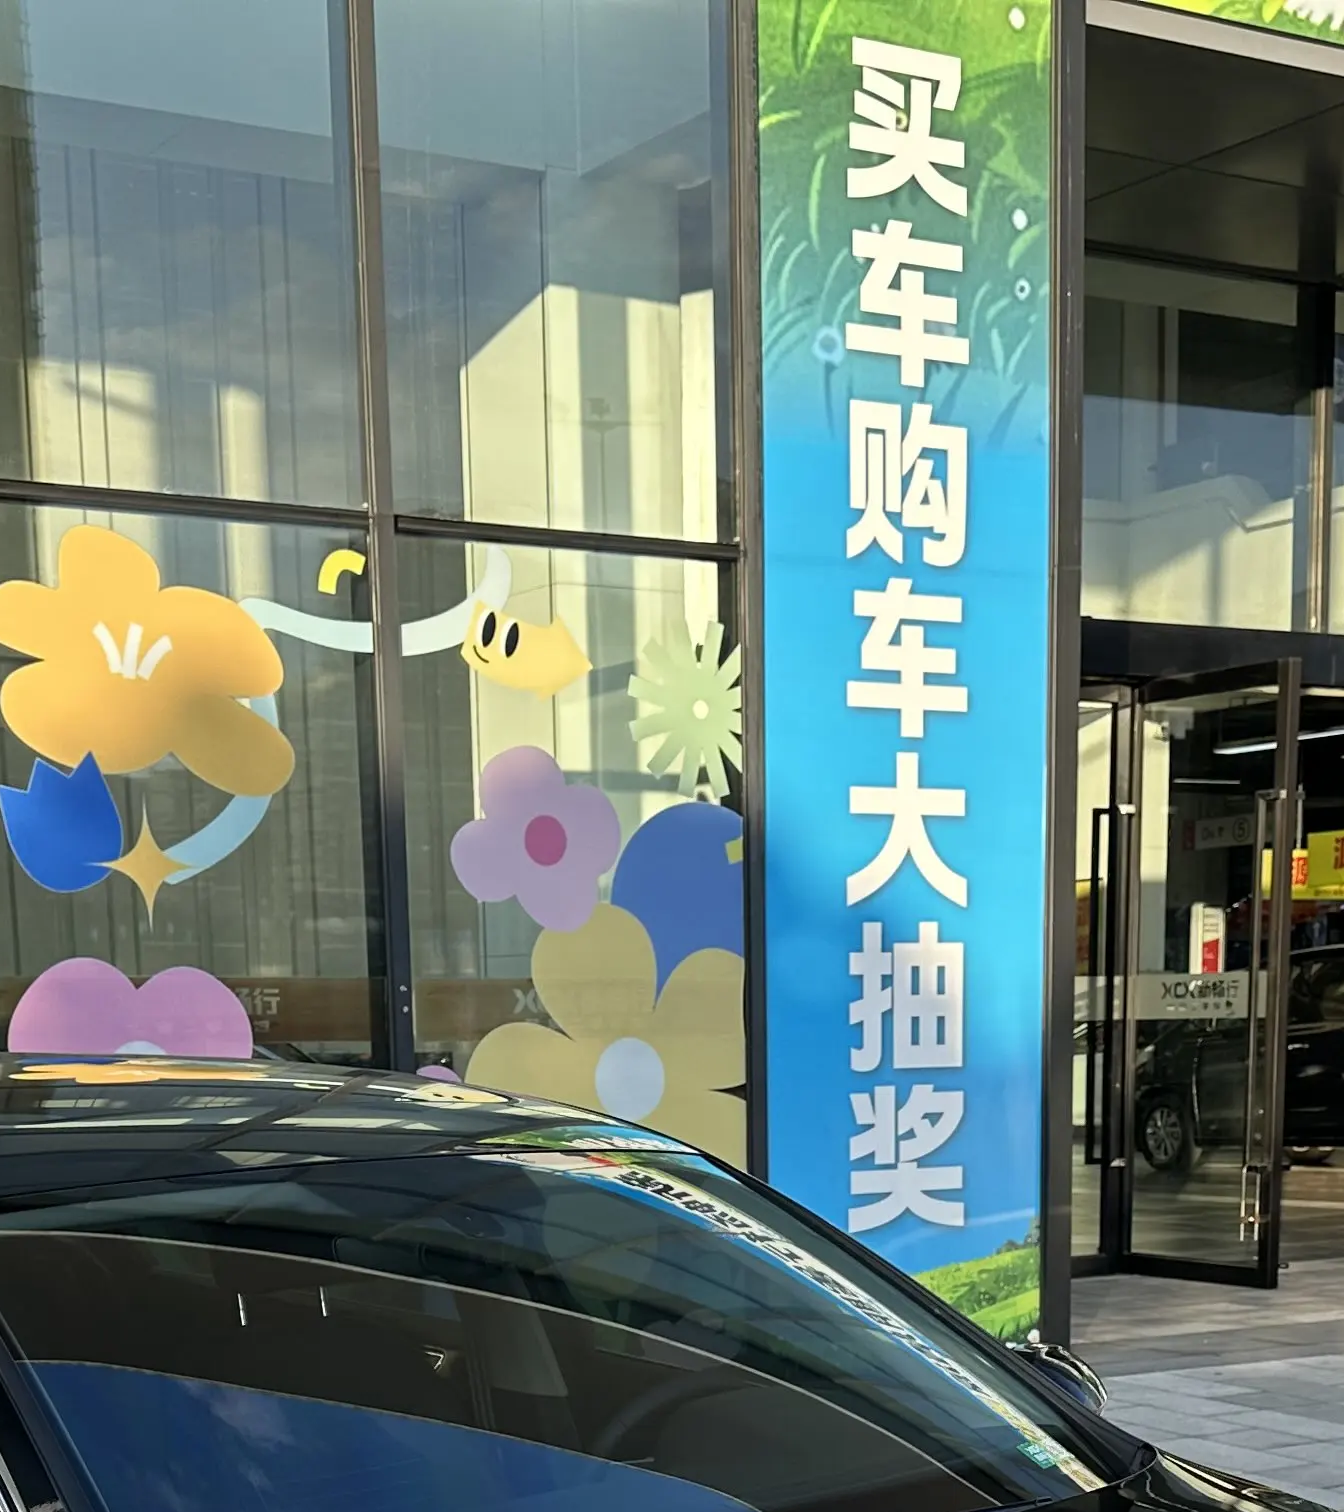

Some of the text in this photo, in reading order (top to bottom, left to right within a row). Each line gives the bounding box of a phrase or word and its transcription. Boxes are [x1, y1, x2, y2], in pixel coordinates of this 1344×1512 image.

[845, 38, 970, 1233] 买车购车大抽奖
